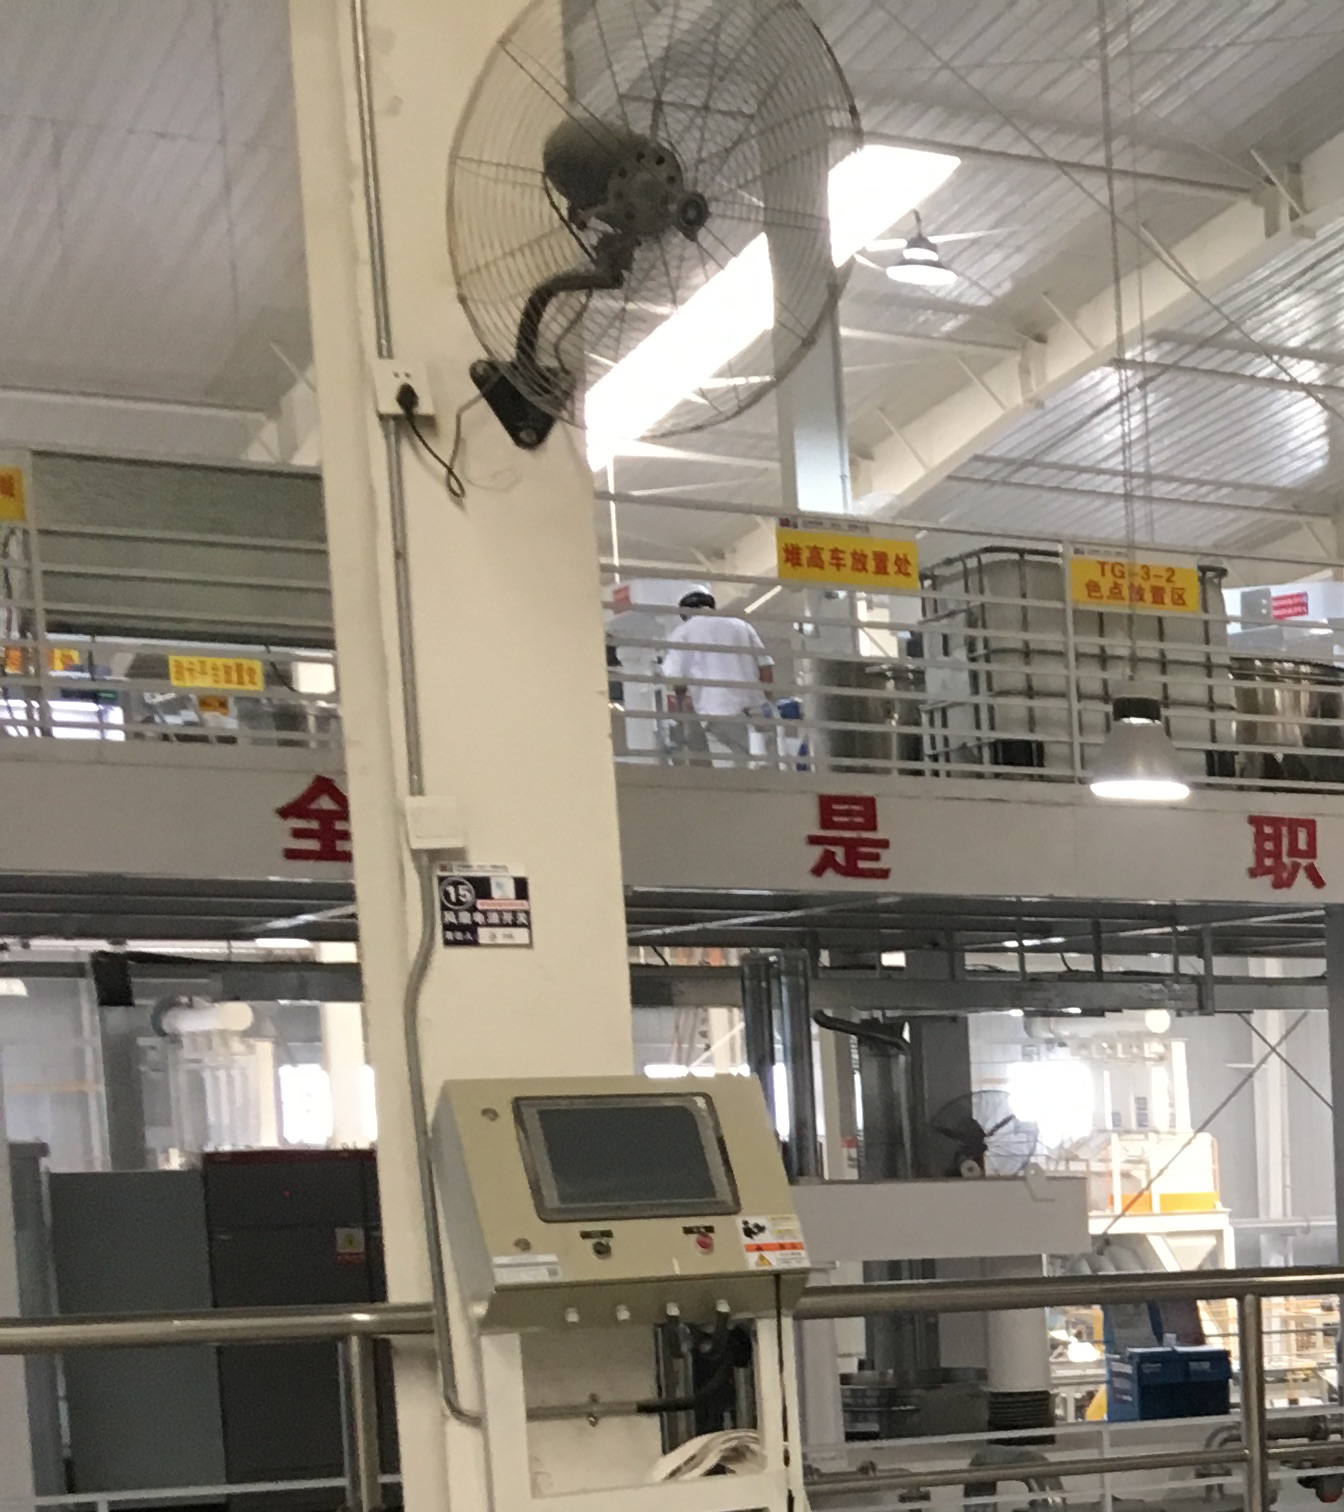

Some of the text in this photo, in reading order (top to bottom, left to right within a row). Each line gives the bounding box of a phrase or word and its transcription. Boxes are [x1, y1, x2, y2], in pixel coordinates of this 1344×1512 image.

[781, 542, 913, 578] 堆高车放置处
[1085, 579, 1188, 607] 色点放置区
[807, 794, 891, 880] 是
[1247, 815, 1327, 890] 职
[445, 884, 472, 903] 15
